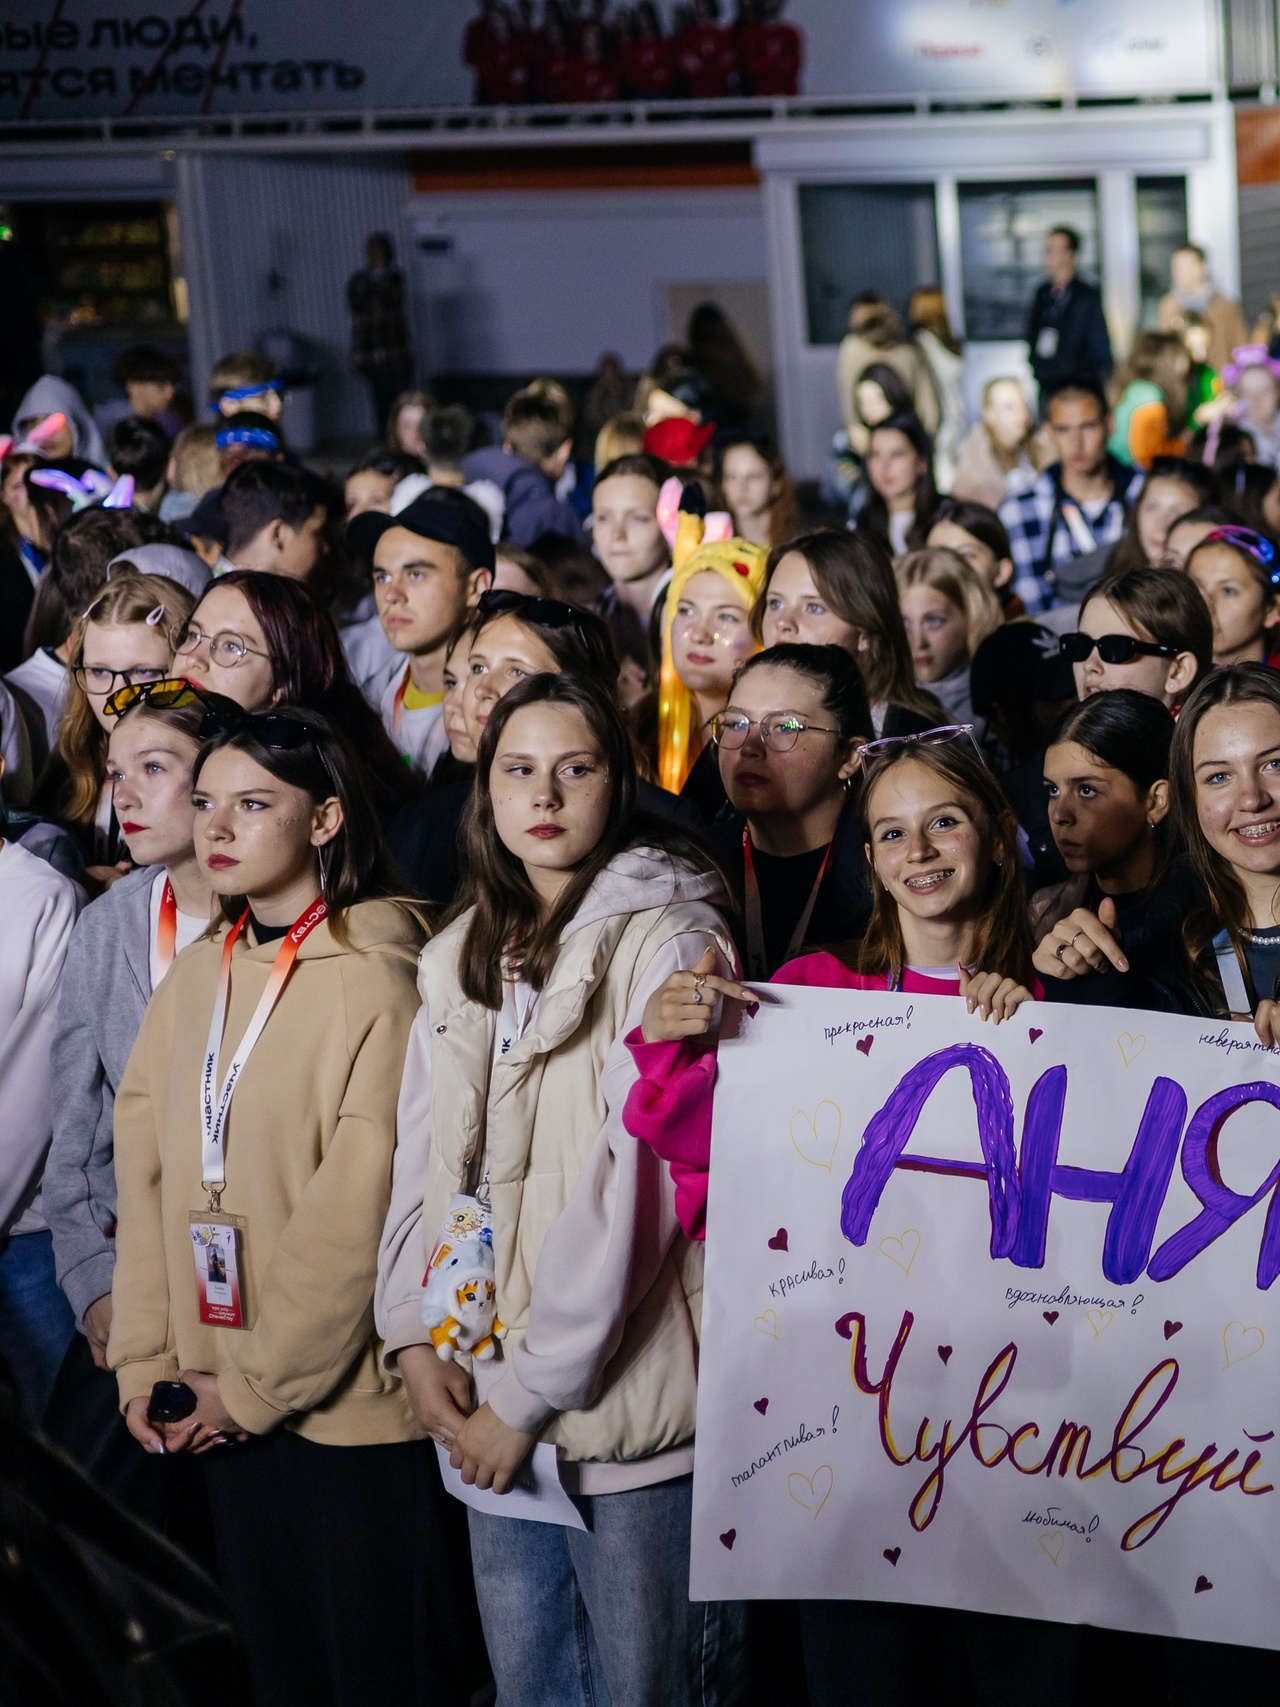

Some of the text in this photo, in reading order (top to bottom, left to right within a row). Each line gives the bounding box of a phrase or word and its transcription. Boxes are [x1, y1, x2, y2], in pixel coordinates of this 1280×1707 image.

[0, 15, 258, 52] ые люди,
[129, 59, 366, 95] мечтать
[824, 1005, 914, 1046] прекрасная!
[205, 1052, 215, 1136] частник
[834, 1310, 1276, 1551] Чувствуй
[1021, 1507, 1100, 1543] любимая!
